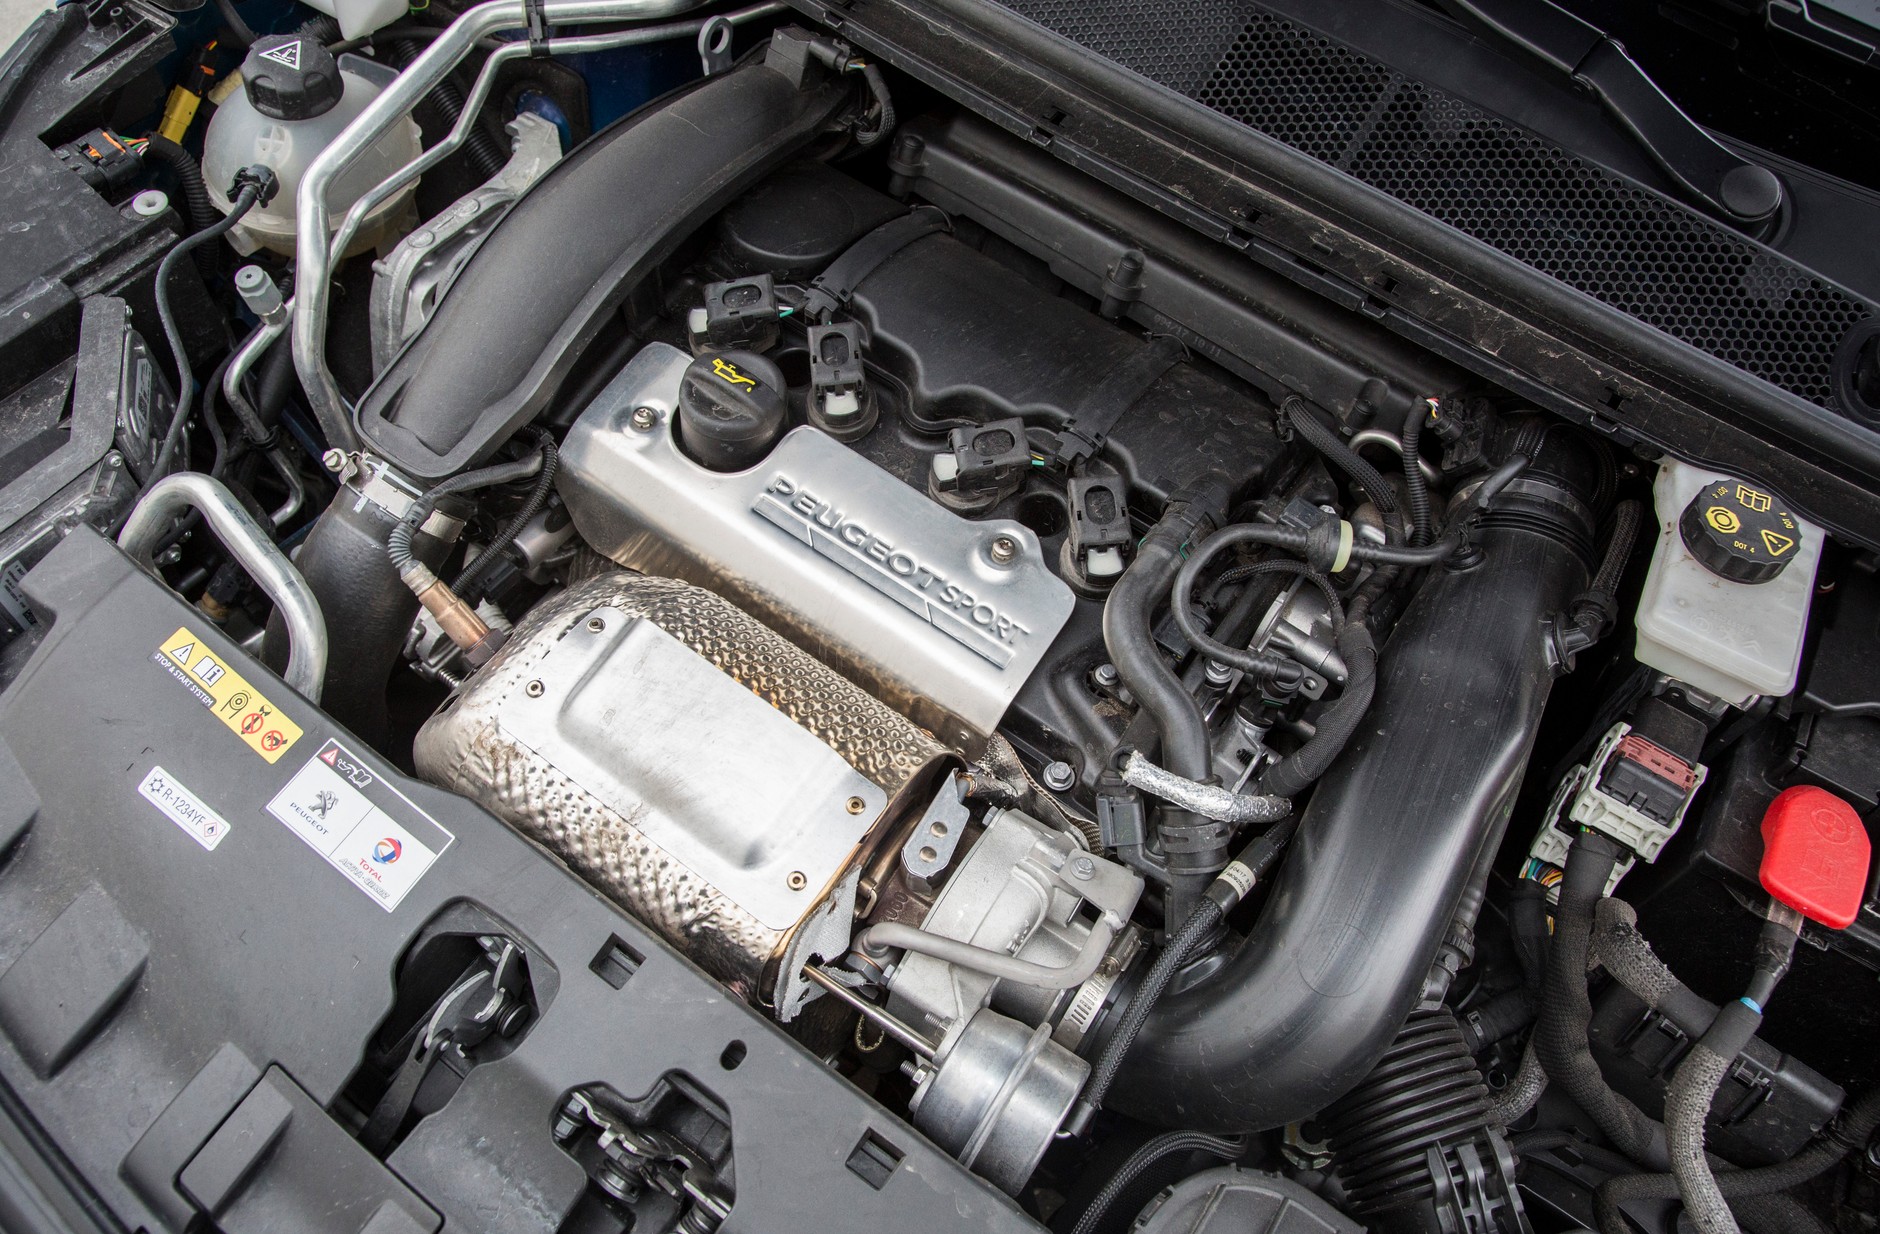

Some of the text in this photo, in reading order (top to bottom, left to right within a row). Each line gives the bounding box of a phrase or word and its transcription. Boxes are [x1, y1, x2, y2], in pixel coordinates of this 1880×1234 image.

[767, 474, 1032, 645] PEUGEOT SPORT
[1734, 541, 1748, 550] DOT
[154, 653, 214, 706] STOP & START SYSTEM
[161, 787, 207, 826] R-1234YF
[289, 802, 329, 836] PEUGEOT
[359, 857, 383, 883] TOTAL
